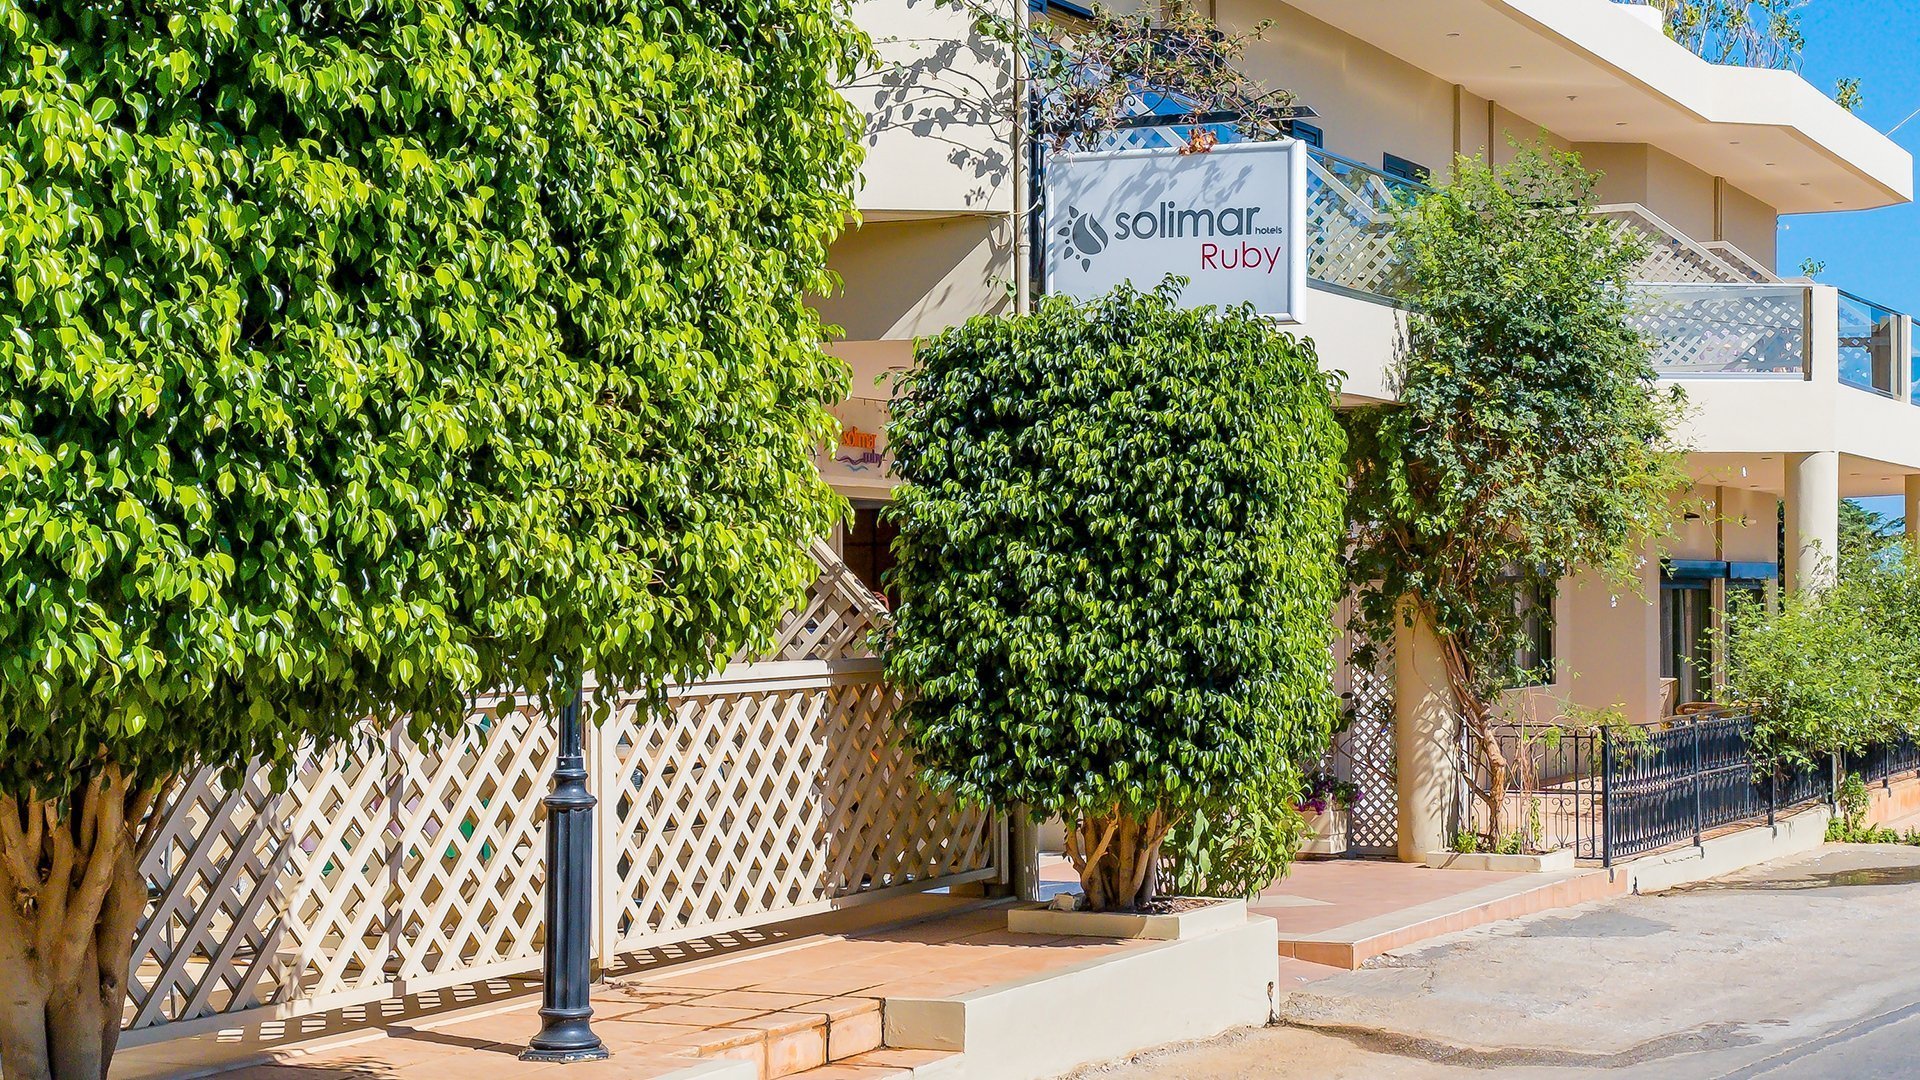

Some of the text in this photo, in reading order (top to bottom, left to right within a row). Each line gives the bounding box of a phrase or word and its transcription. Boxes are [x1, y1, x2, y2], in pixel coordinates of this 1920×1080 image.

[1114, 201, 1283, 240] solimar hotels
[1201, 241, 1282, 274] Ruby
